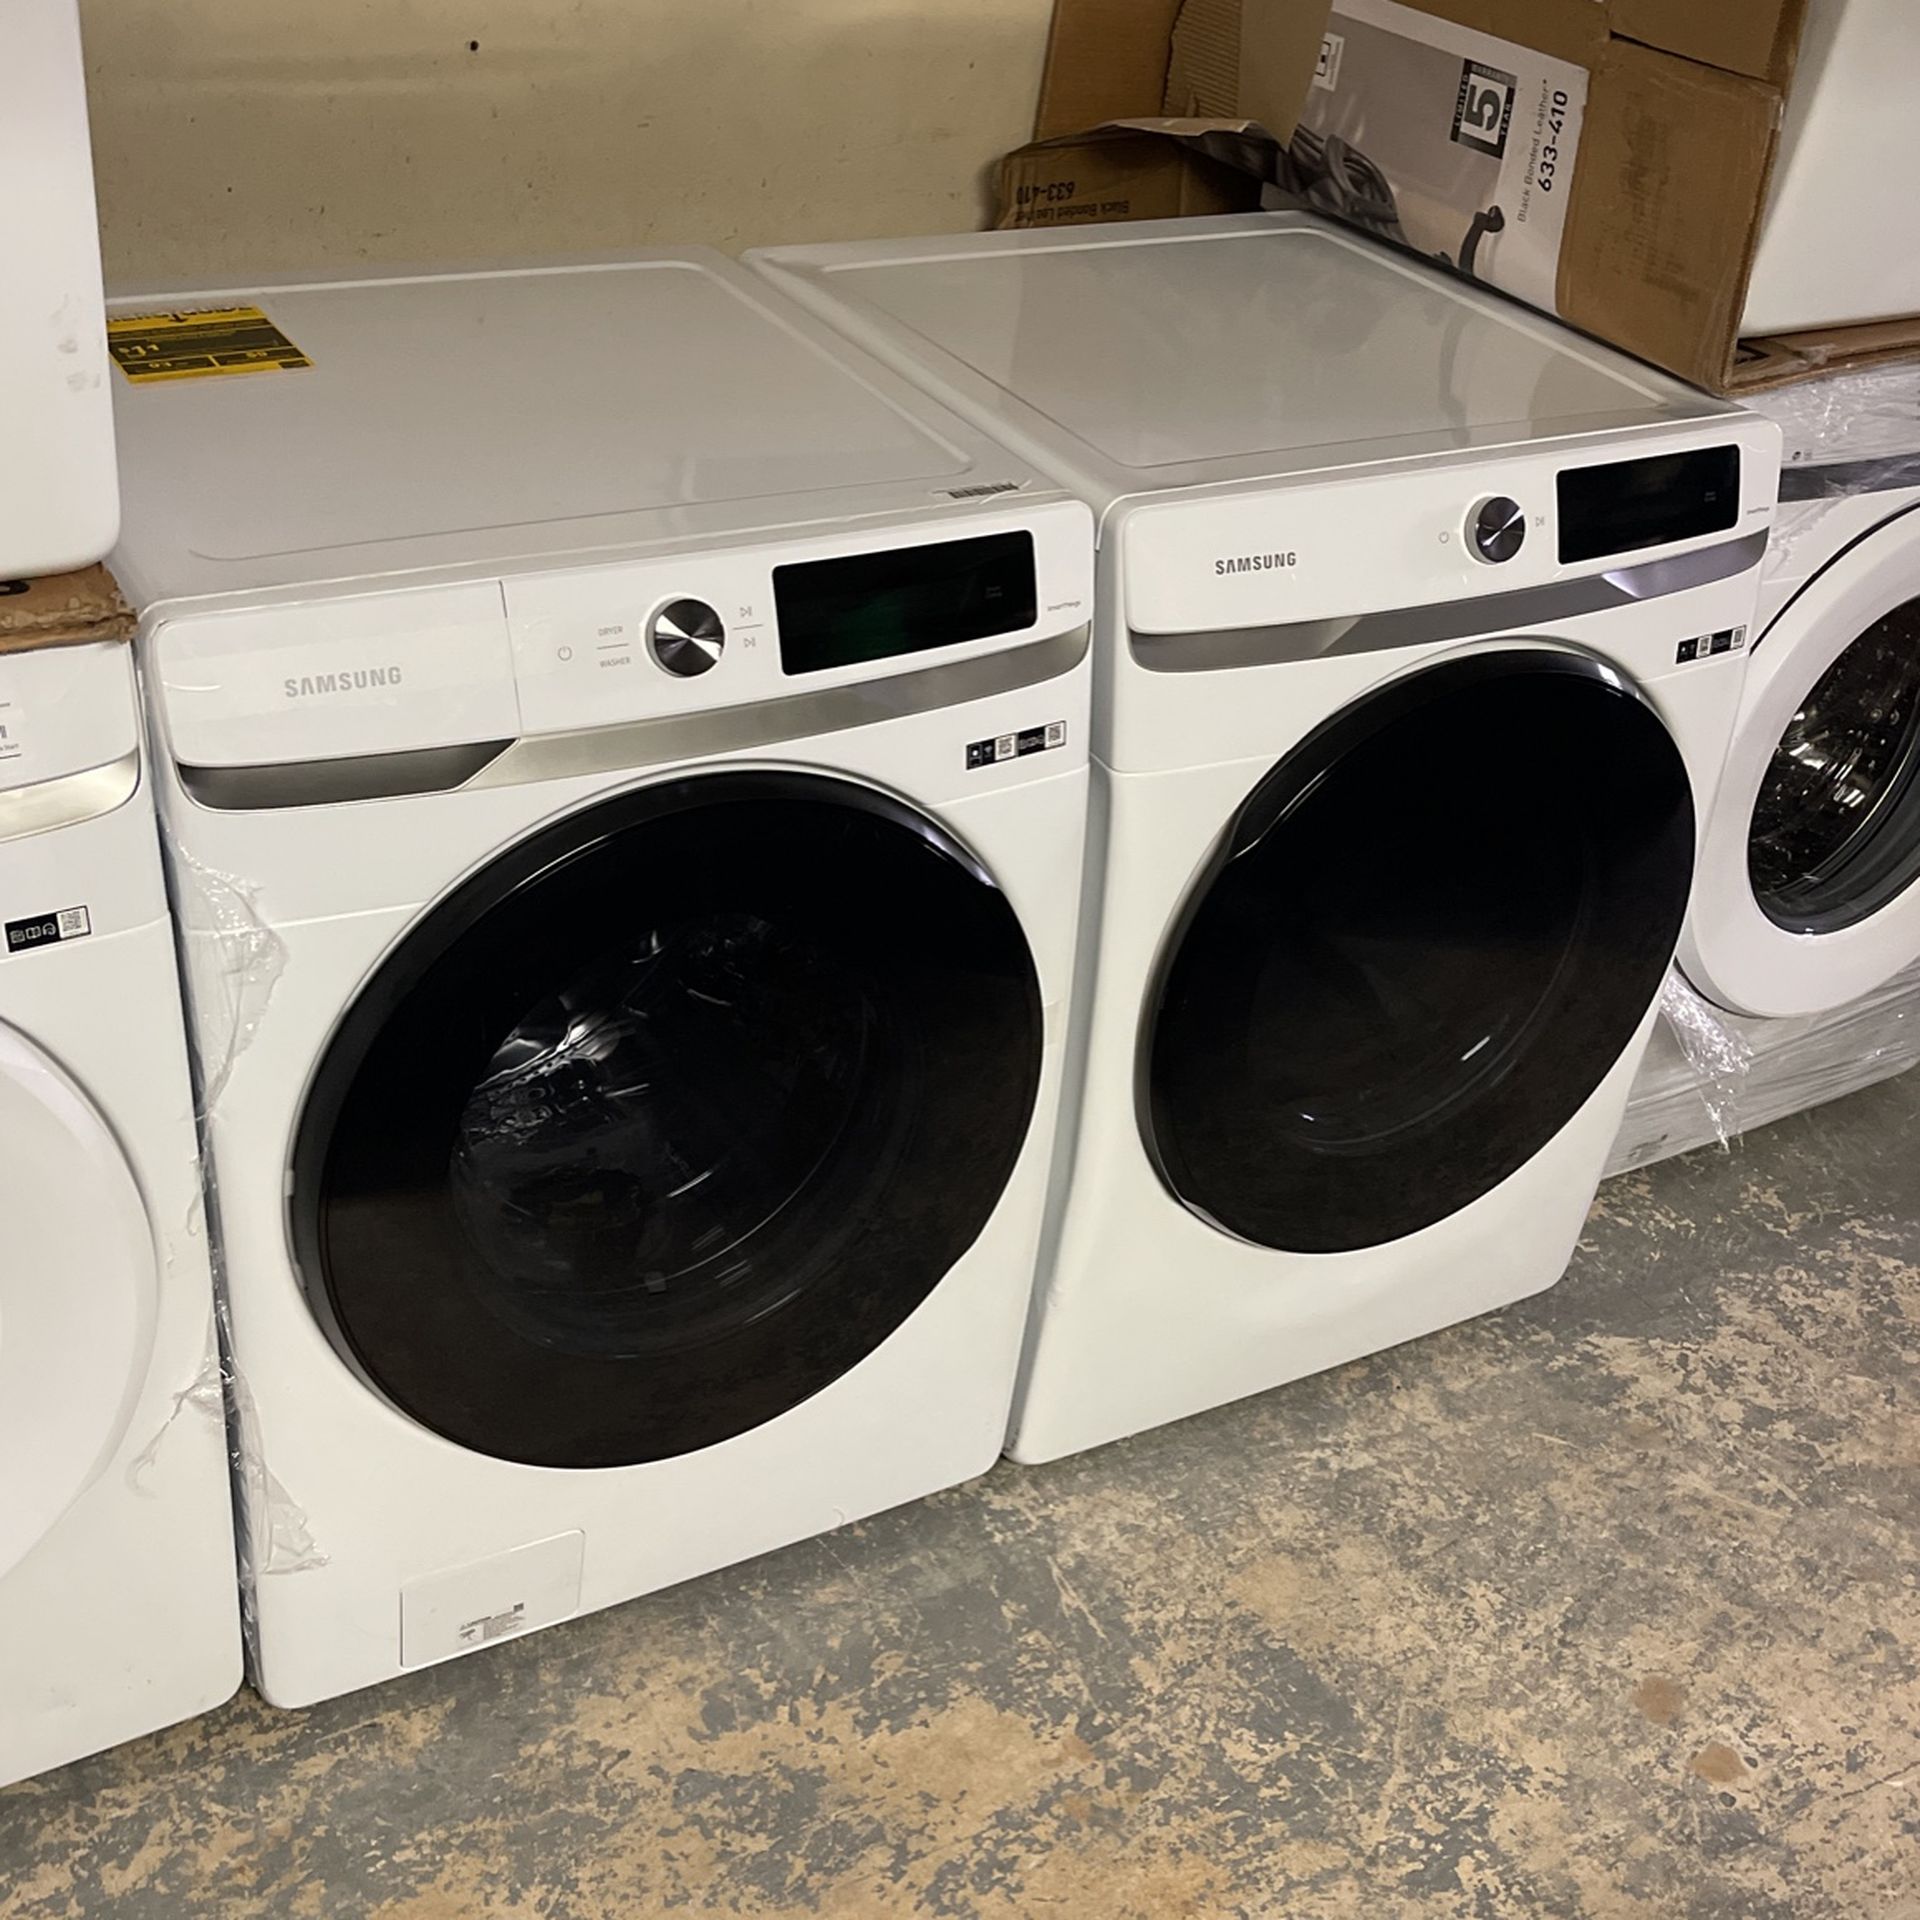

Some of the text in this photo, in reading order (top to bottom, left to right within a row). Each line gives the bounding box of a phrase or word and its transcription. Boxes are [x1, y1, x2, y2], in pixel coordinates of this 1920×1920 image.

[1454, 73, 1470, 128] LIMITED
[1463, 84, 1501, 132] 5
[1501, 103, 1513, 136] YEAR
[1537, 90, 1569, 193] 633-410
[1016, 181, 1076, 206] 633-410
[1517, 189, 1531, 223] Black
[1524, 138, 1541, 185] Bonded
[1215, 551, 1297, 576] SAMSUNG
[598, 625, 624, 637] DRYER
[599, 656, 631, 669] WASHER
[284, 665, 402, 699] SAMSUNG
